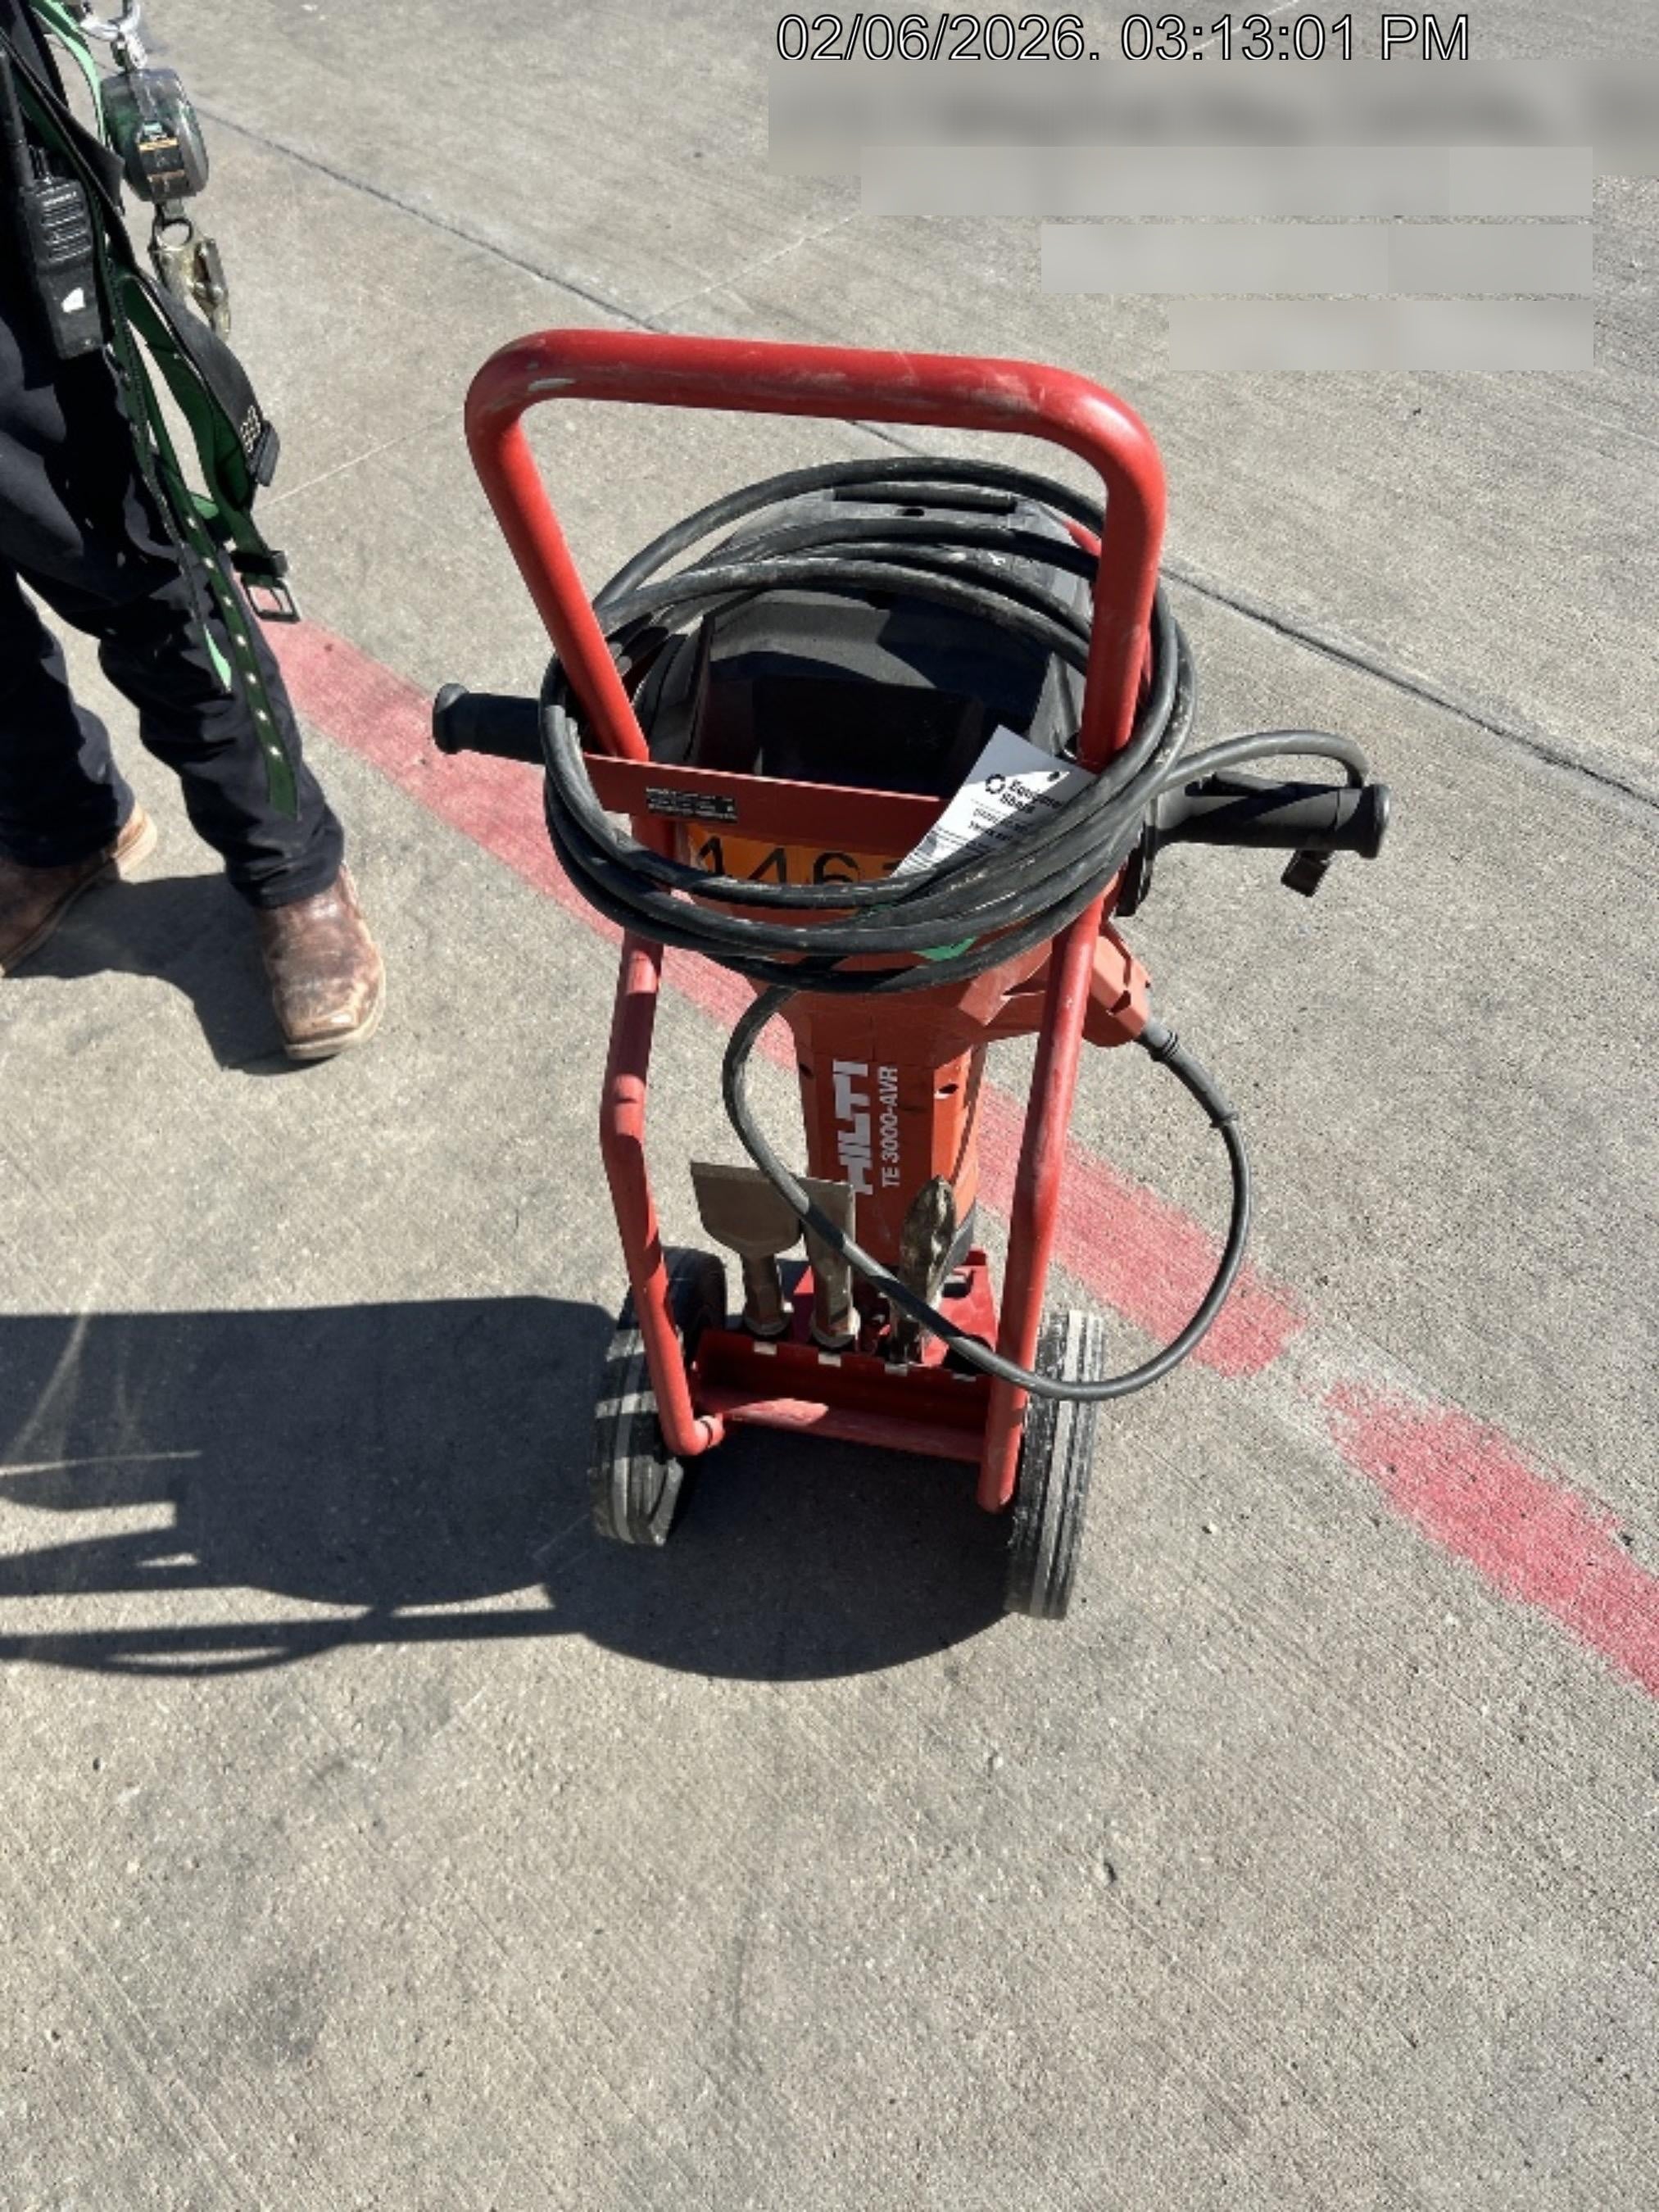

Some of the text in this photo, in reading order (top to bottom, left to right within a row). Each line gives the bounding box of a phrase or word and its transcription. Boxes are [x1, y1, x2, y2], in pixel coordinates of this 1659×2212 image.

[698, 835, 903, 885] 146
[832, 1058, 873, 1195] HILTI
[878, 1066, 900, 1187] TE 3000-AVR
